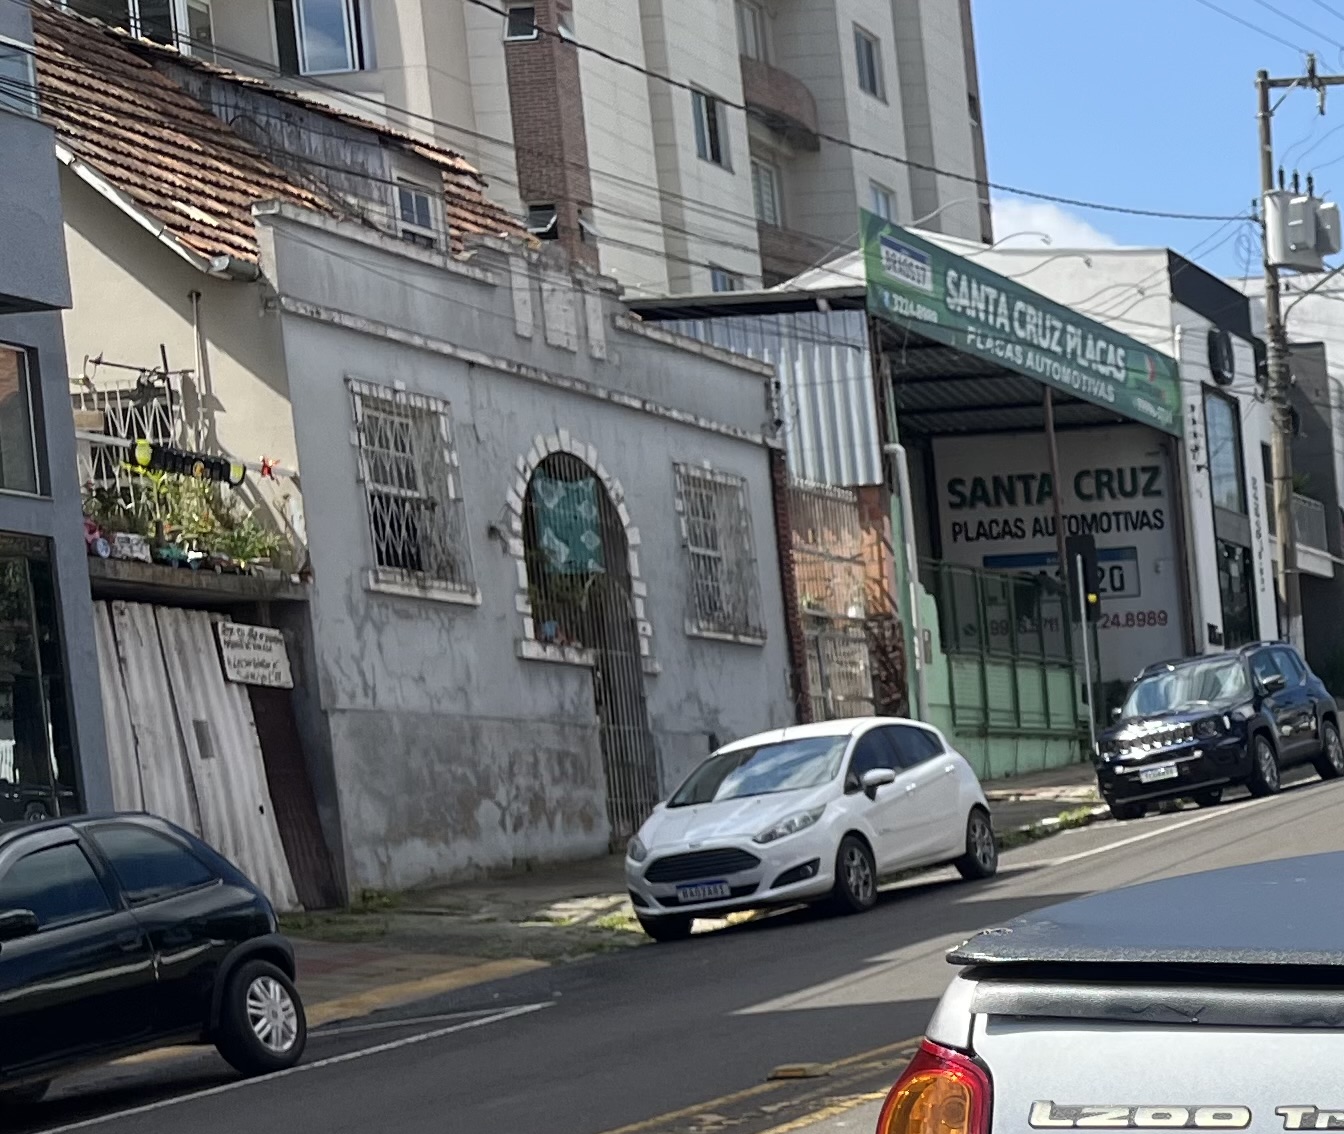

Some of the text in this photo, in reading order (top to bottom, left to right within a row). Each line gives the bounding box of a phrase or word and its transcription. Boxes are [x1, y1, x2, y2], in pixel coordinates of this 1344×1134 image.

[946, 269, 1127, 383] SANTA CRUZ PLACAS
[966, 325, 1024, 365] PLACAS
[1025, 351, 1116, 402] AUTOMOTIVAS
[947, 465, 1163, 510] SANTA CRUZ
[952, 517, 1026, 543] PLACAS
[1101, 610, 1168, 629] 24.8989
[1029, 1100, 1251, 1129] L200
